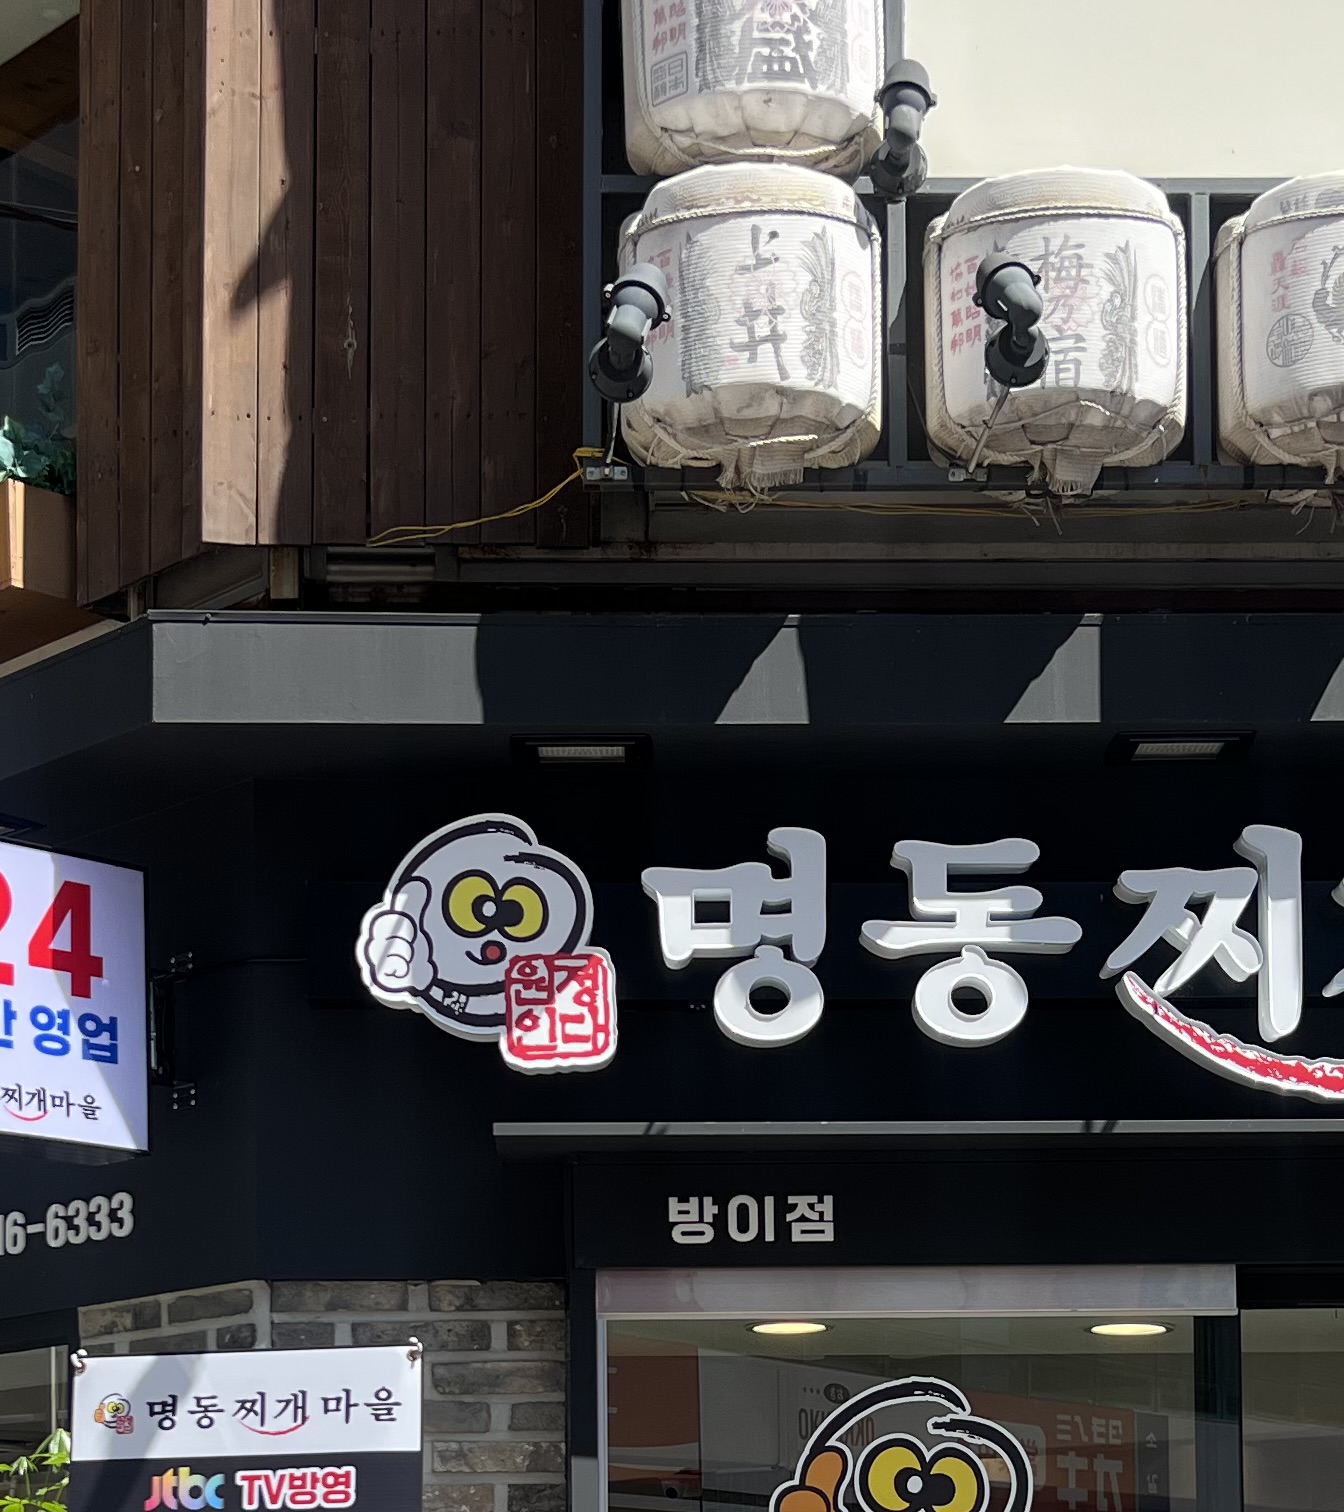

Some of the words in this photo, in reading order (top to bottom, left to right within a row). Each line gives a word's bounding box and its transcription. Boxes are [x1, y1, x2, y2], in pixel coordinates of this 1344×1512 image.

[29, 1005, 119, 1064] 영업
[666, 1194, 836, 1246] 방이점
[146, 1385, 403, 1430] 명동찌개마을
[237, 1467, 355, 1509] TV방영
